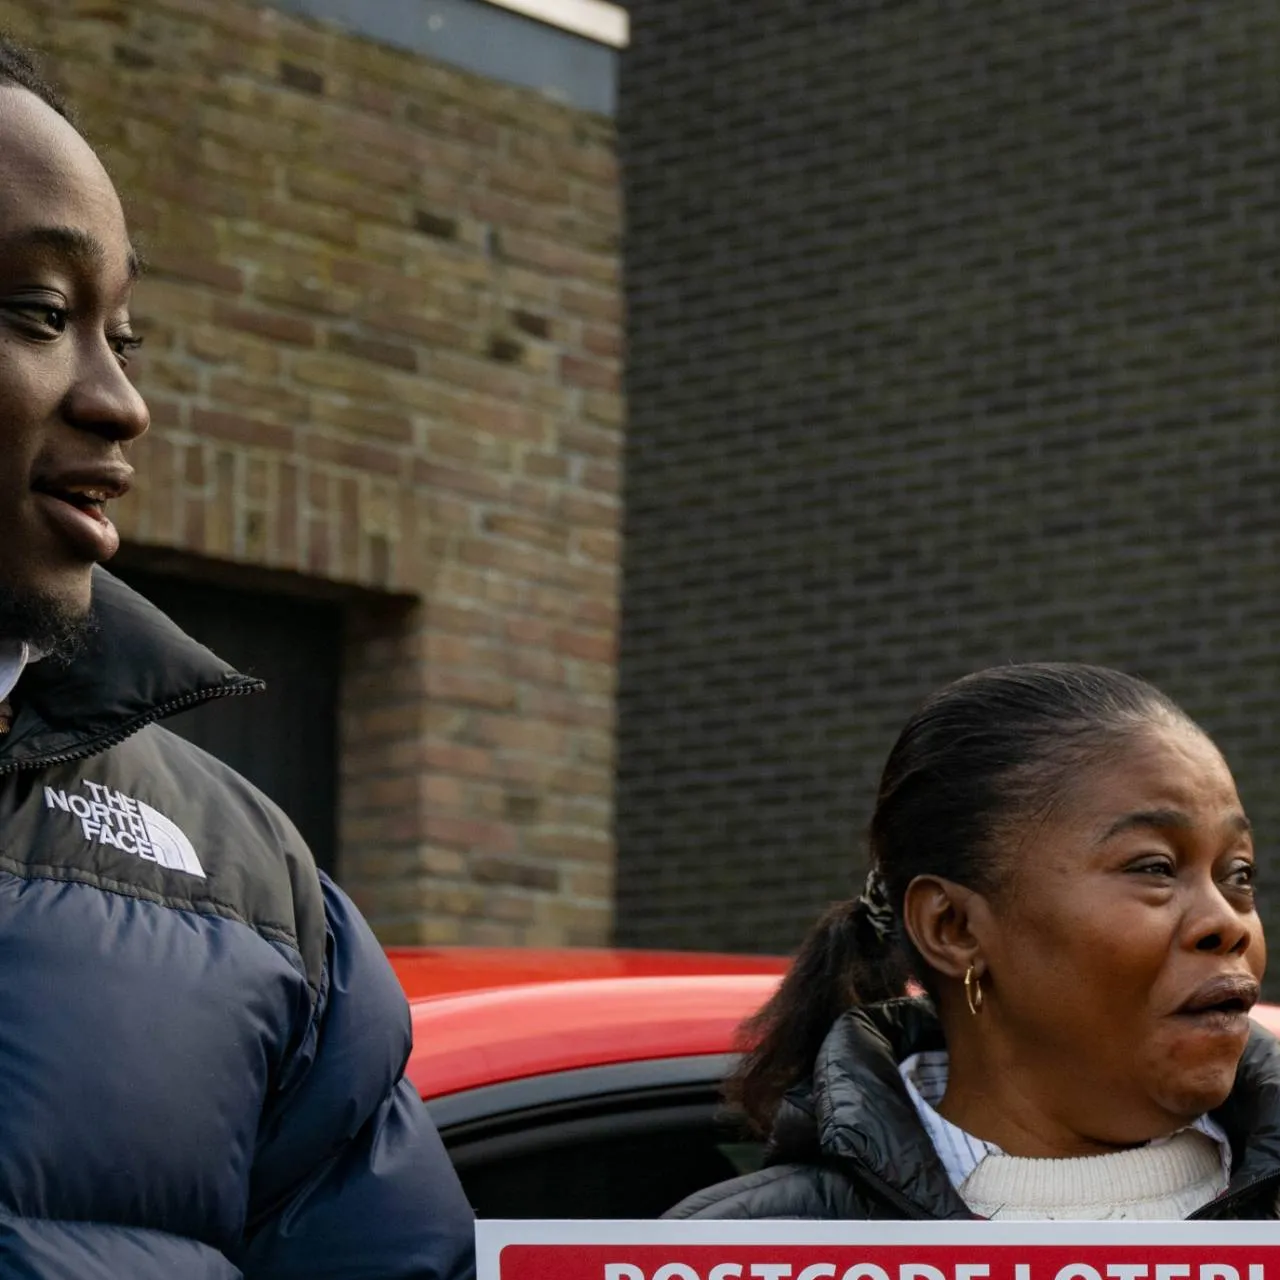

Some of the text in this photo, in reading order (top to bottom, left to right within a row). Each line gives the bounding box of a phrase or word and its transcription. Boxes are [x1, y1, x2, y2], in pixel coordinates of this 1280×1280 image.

[44, 786, 150, 842] NORTH
[83, 779, 138, 814] THE
[81, 819, 157, 862] FACE
